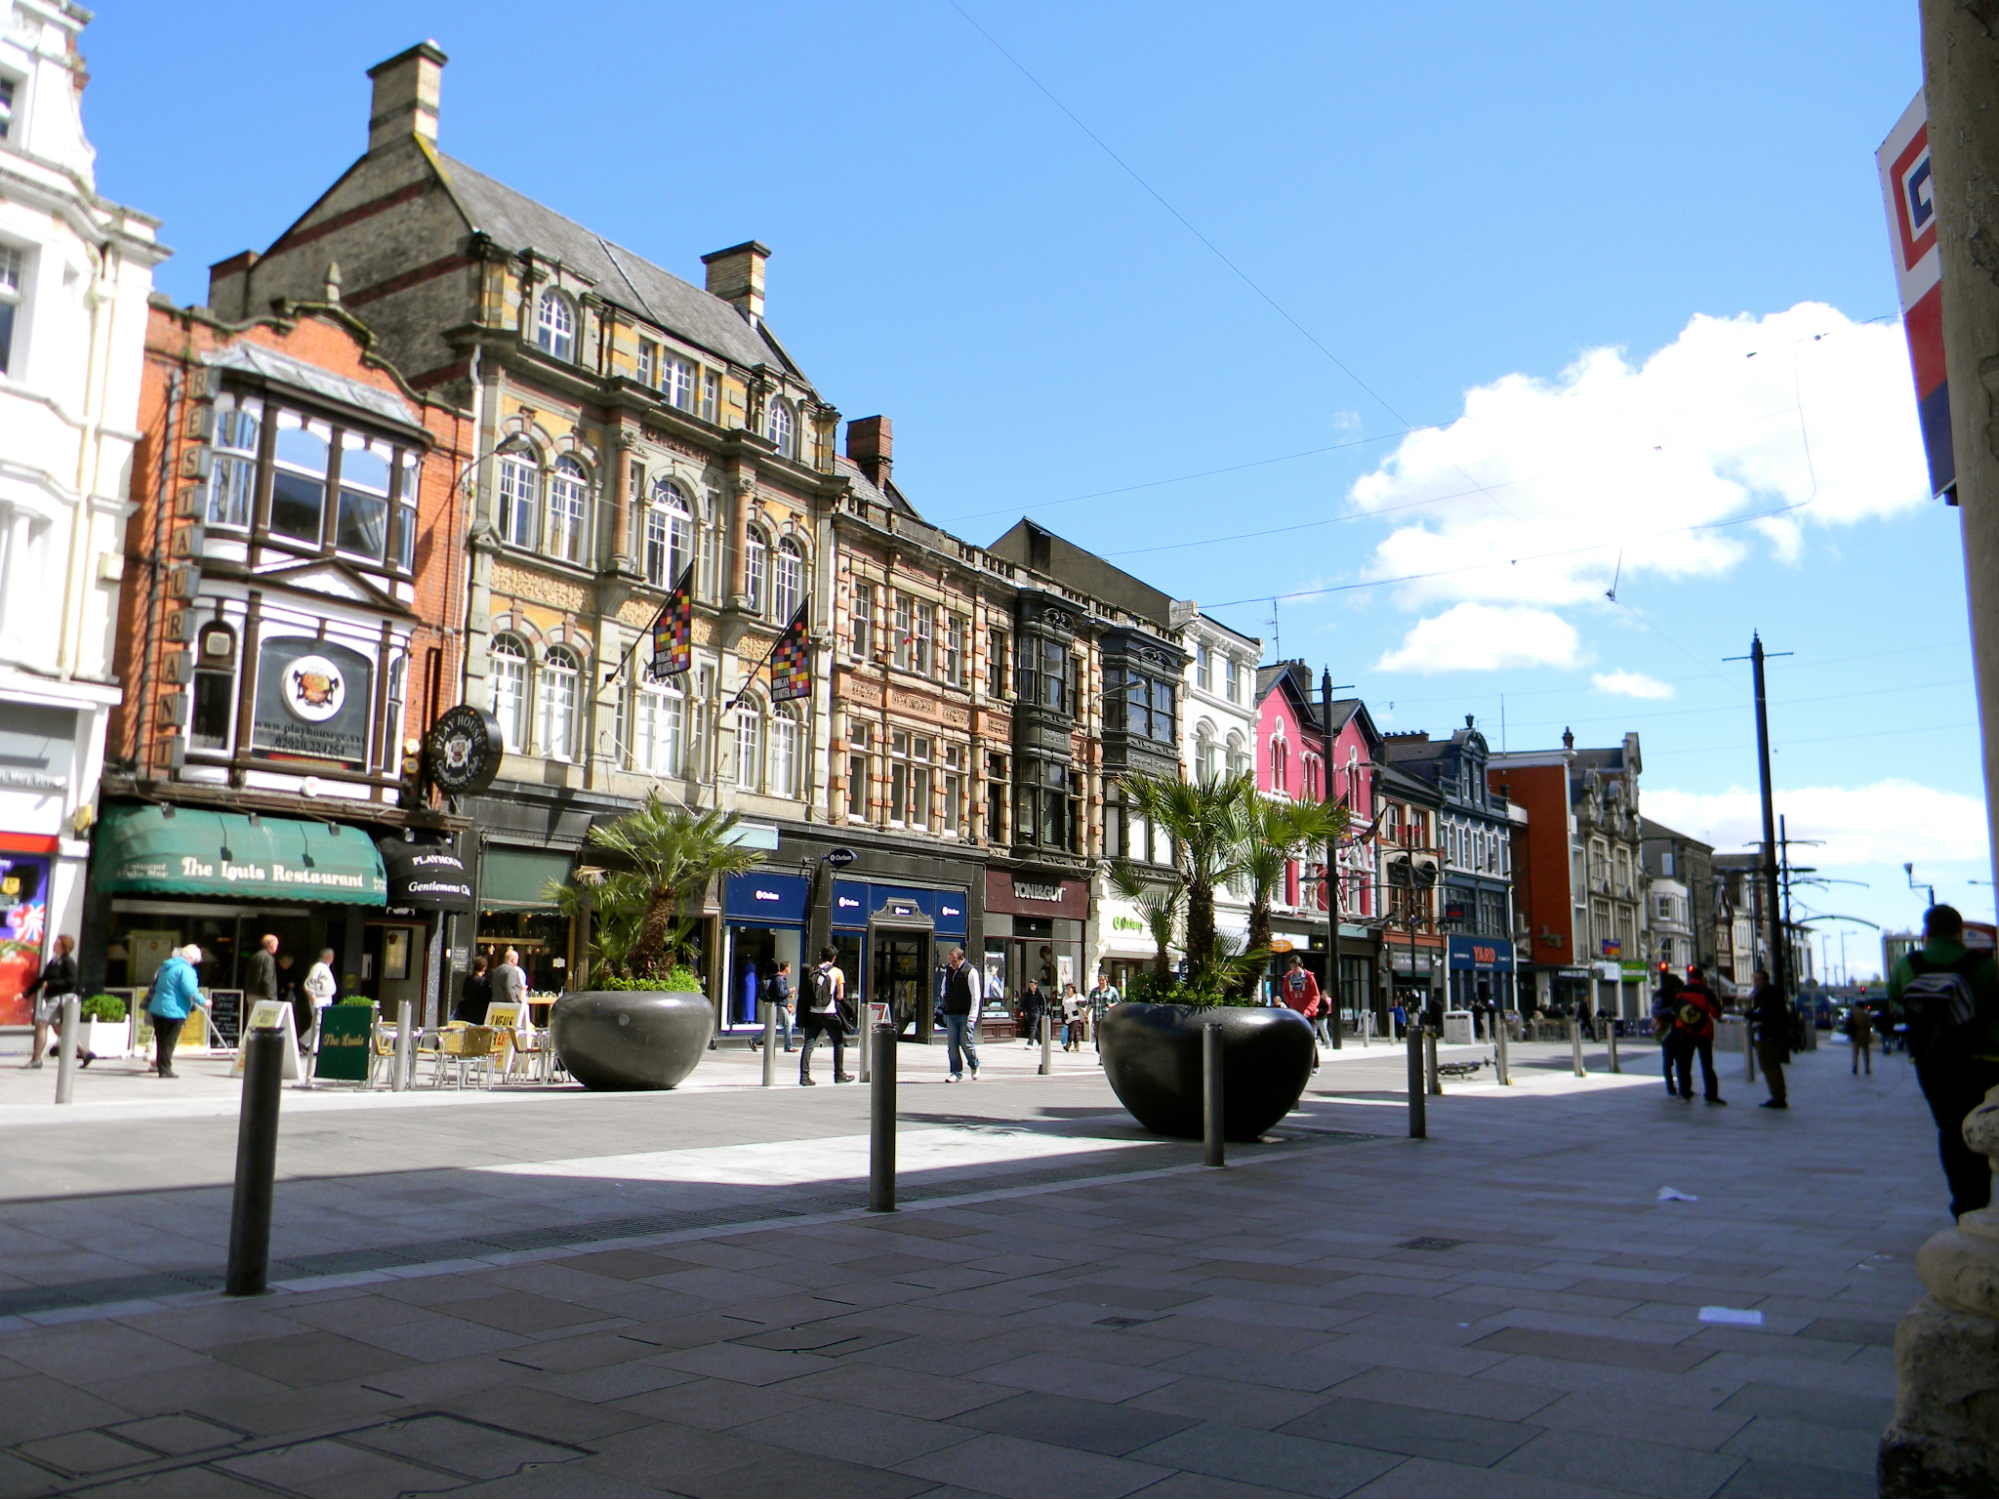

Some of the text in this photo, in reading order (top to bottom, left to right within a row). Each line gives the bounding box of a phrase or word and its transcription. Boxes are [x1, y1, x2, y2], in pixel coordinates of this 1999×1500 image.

[157, 368, 209, 764] RESTAURANT
[772, 678, 789, 689] MORGAN
[772, 688, 791, 700] QUARTER
[457, 715, 482, 745] HOUSE
[182, 856, 214, 877] The
[221, 860, 266, 881] Louis
[272, 864, 364, 888] Restaurant
[408, 881, 460, 893] Gentlemens
[1014, 881, 1067, 902] TONI&GUY
[761, 891, 780, 900] Oxfam
[844, 899, 860, 907] Oxfam
[947, 908, 960, 916] Oxfam
[1472, 946, 1496, 963] YARD
[322, 1033, 365, 1048] The Louis
